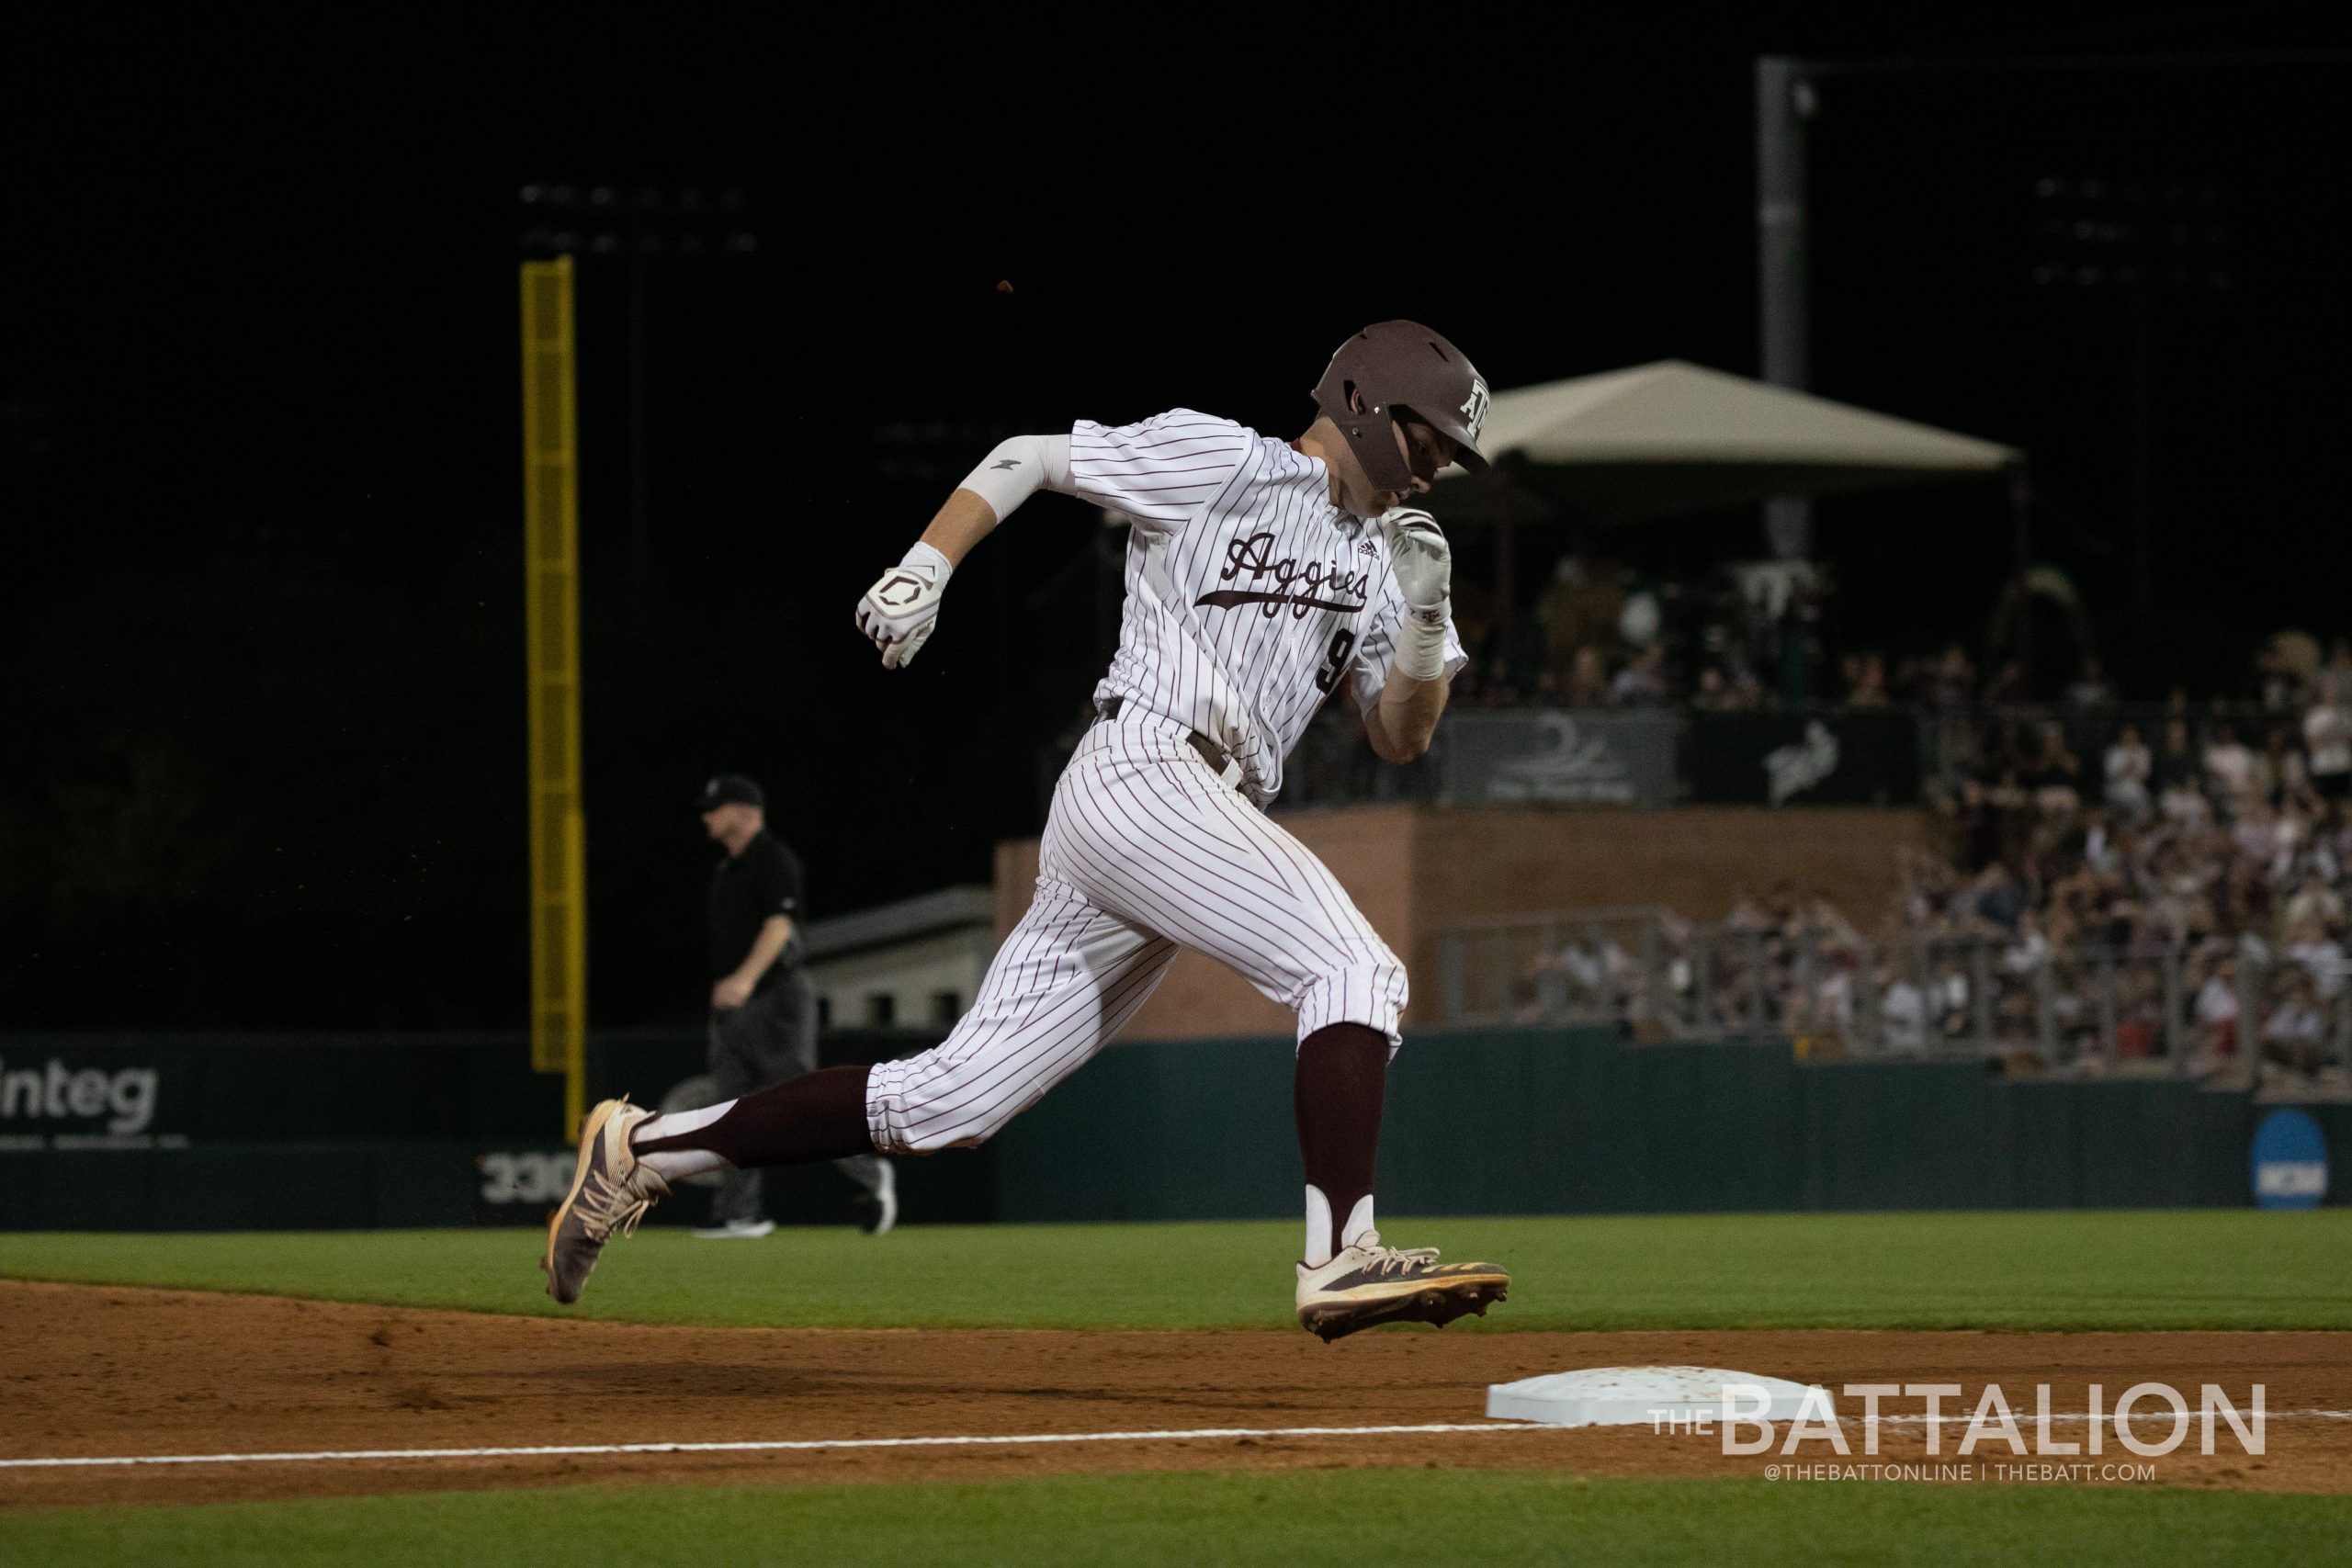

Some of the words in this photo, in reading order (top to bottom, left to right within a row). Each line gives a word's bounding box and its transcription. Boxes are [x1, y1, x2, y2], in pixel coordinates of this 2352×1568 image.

[1220, 532, 1369, 620] Aggies
[1315, 628, 1356, 694] 9
[0, 1057, 160, 1134] nteg
